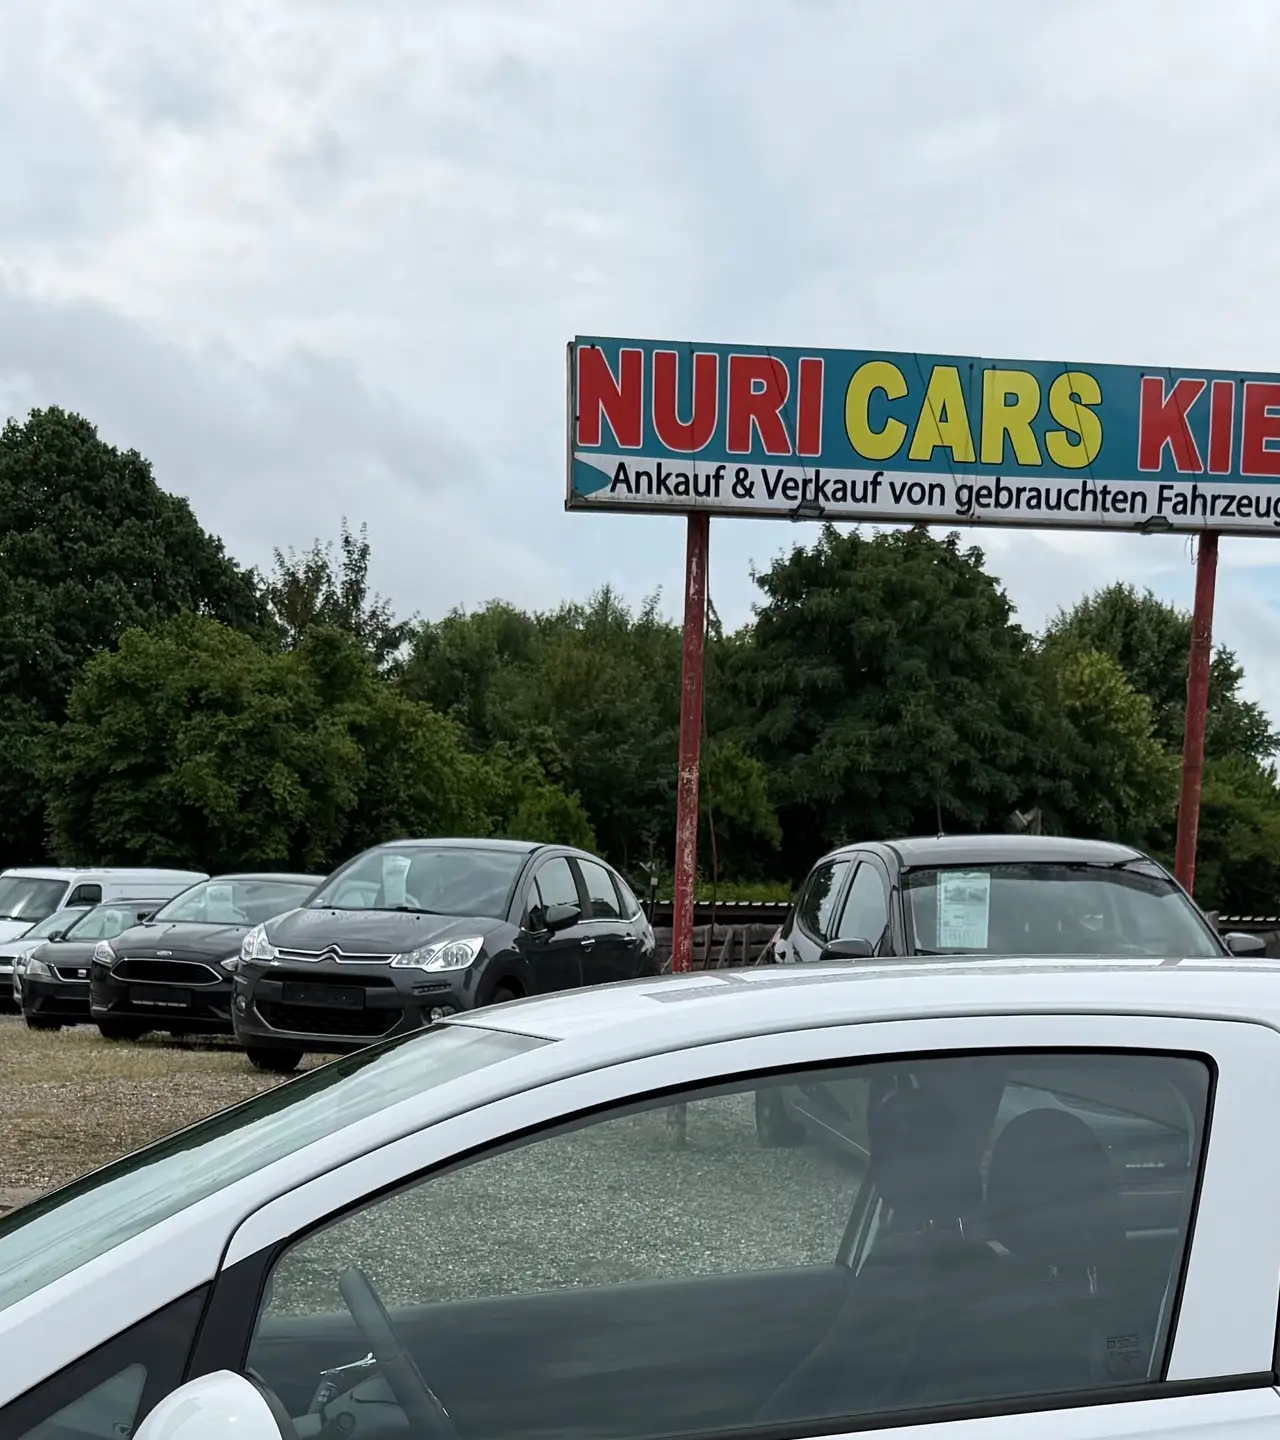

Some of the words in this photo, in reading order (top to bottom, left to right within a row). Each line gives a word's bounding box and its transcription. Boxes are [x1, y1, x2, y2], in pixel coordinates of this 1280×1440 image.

[577, 346, 824, 457] NURI
[844, 360, 1103, 468] CARS
[610, 461, 726, 499] Ankauf
[732, 467, 755, 500] &
[761, 468, 884, 504] Verkauf
[889, 480, 945, 507] von
[954, 477, 1148, 516] gebrauchten
